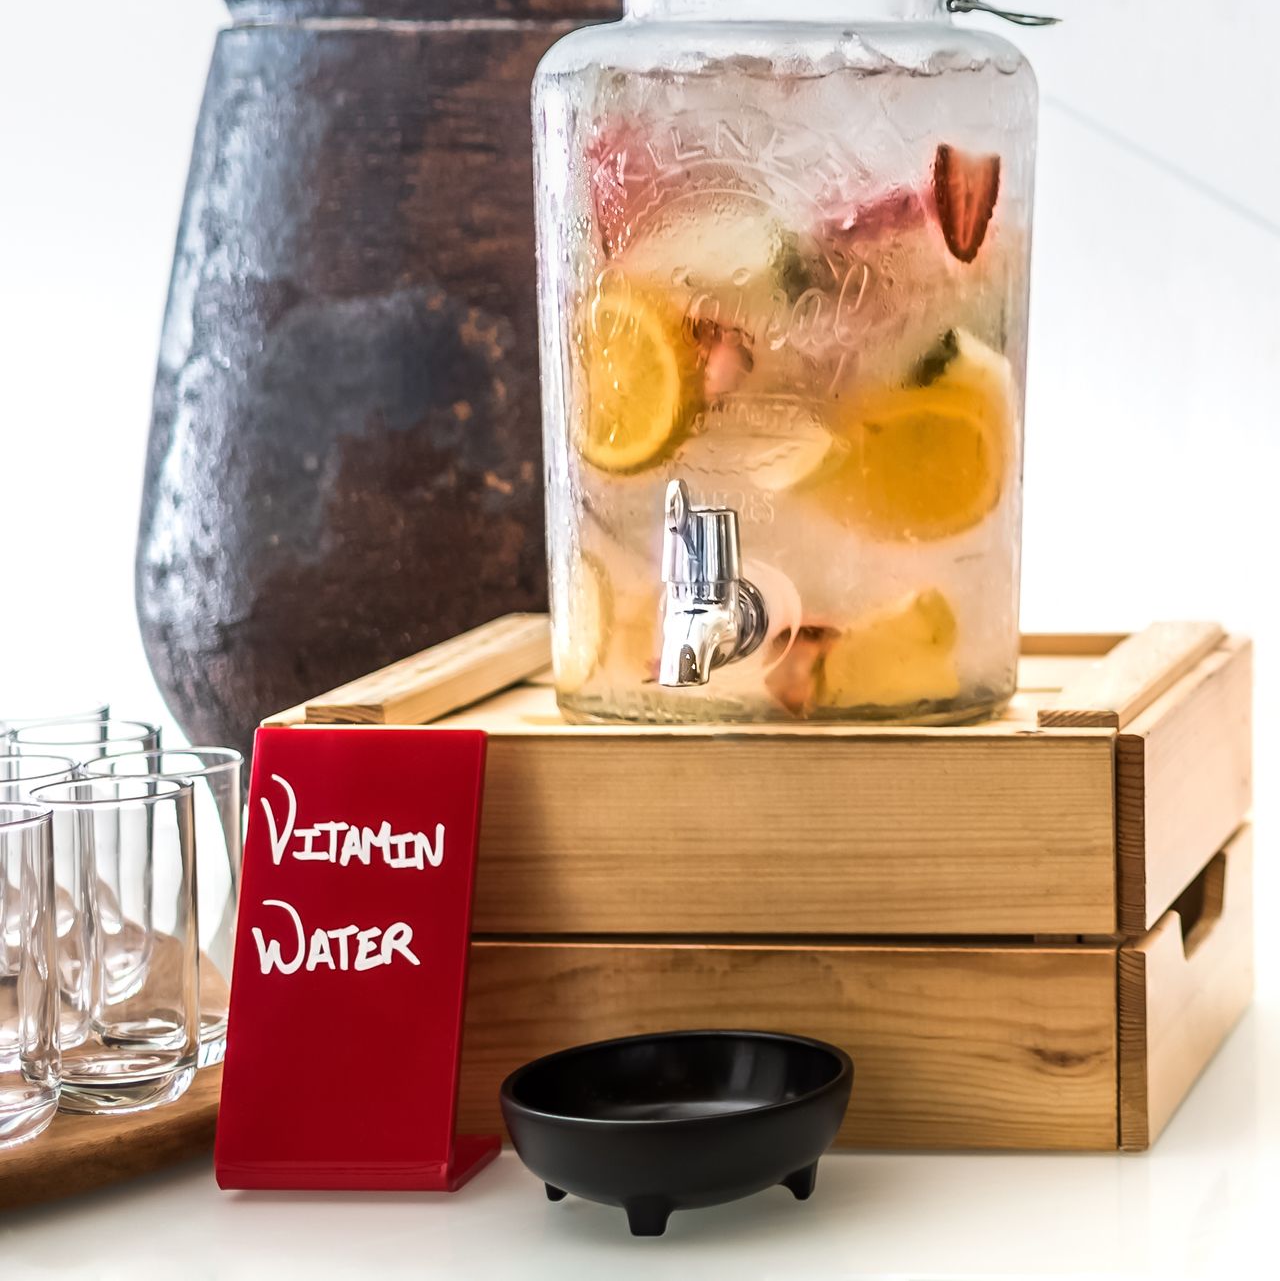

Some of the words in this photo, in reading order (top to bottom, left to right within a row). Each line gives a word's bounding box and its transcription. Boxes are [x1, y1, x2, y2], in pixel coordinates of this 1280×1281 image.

[590, 264, 872, 368] Oiginal
[261, 774, 447, 872] VITAMIN
[252, 900, 422, 976] WATER
